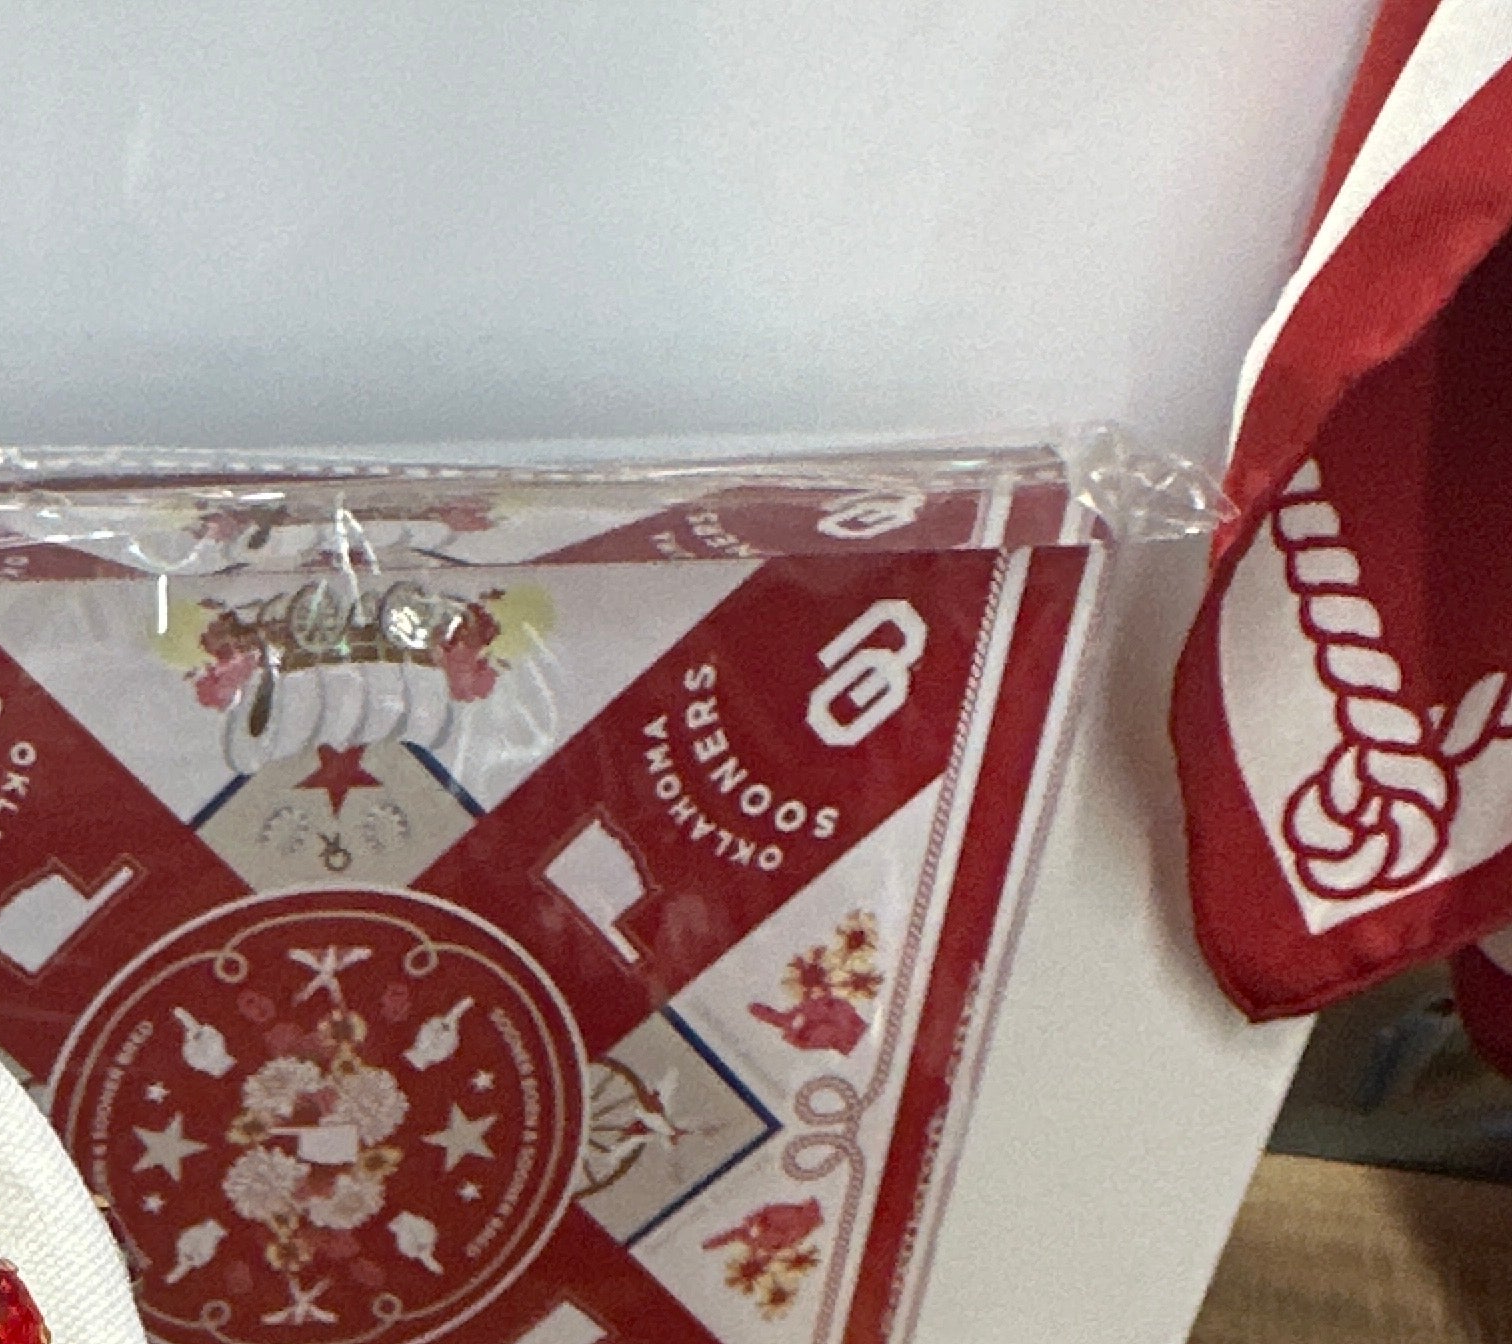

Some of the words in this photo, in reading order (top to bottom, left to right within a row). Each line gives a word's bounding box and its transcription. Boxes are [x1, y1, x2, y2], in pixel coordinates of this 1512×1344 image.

[684, 664, 839, 838] SOONERS
[806, 598, 927, 747] OU
[642, 714, 783, 871] OKLAHOMA
